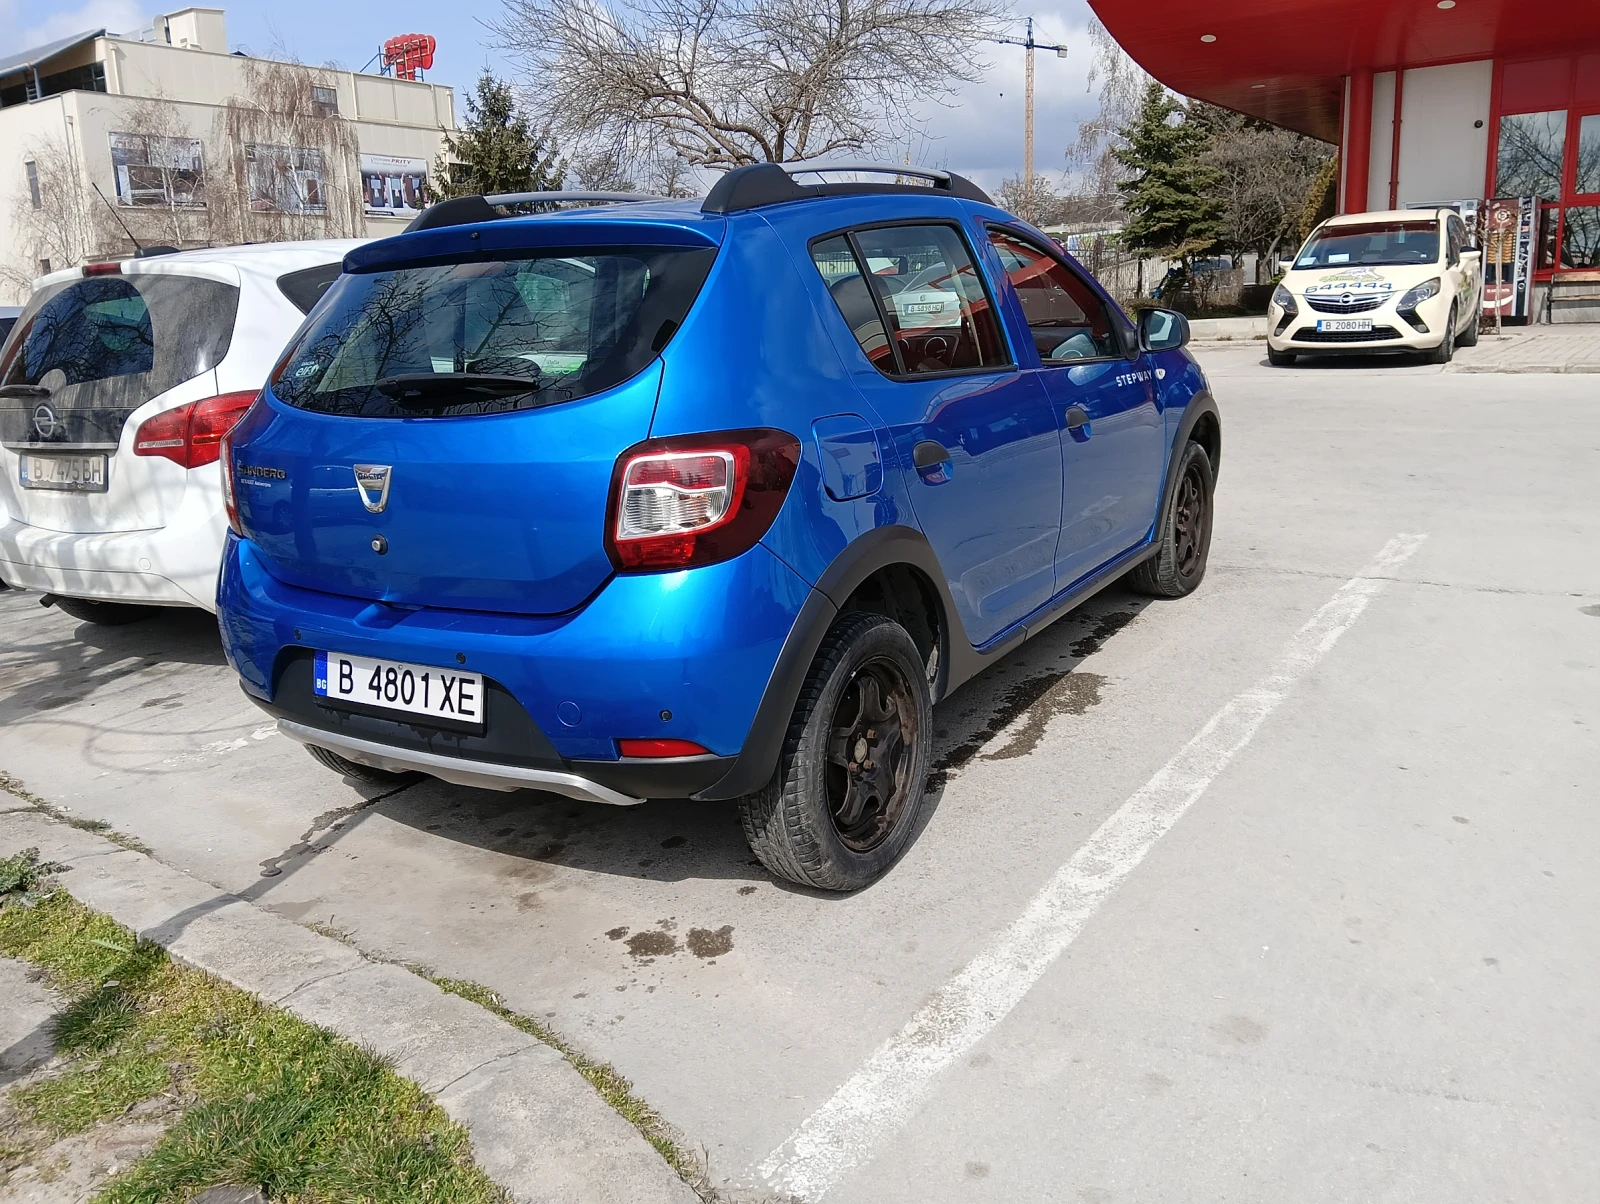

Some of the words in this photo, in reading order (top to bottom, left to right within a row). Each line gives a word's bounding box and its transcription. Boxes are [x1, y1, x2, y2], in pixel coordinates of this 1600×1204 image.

[1305, 282, 1392, 293] 644444
[1325, 322, 1331, 330] B
[1335, 321, 1357, 330] 2080
[1358, 321, 1370, 329] HH
[1115, 369, 1152, 387] STEPWAY
[34, 459, 43, 479] B
[82, 459, 101, 482] BH
[237, 464, 287, 480] SANDERO
[316, 678, 327, 690] BG
[339, 659, 354, 694] B
[368, 665, 430, 708] 4801
[439, 674, 475, 716] XE
